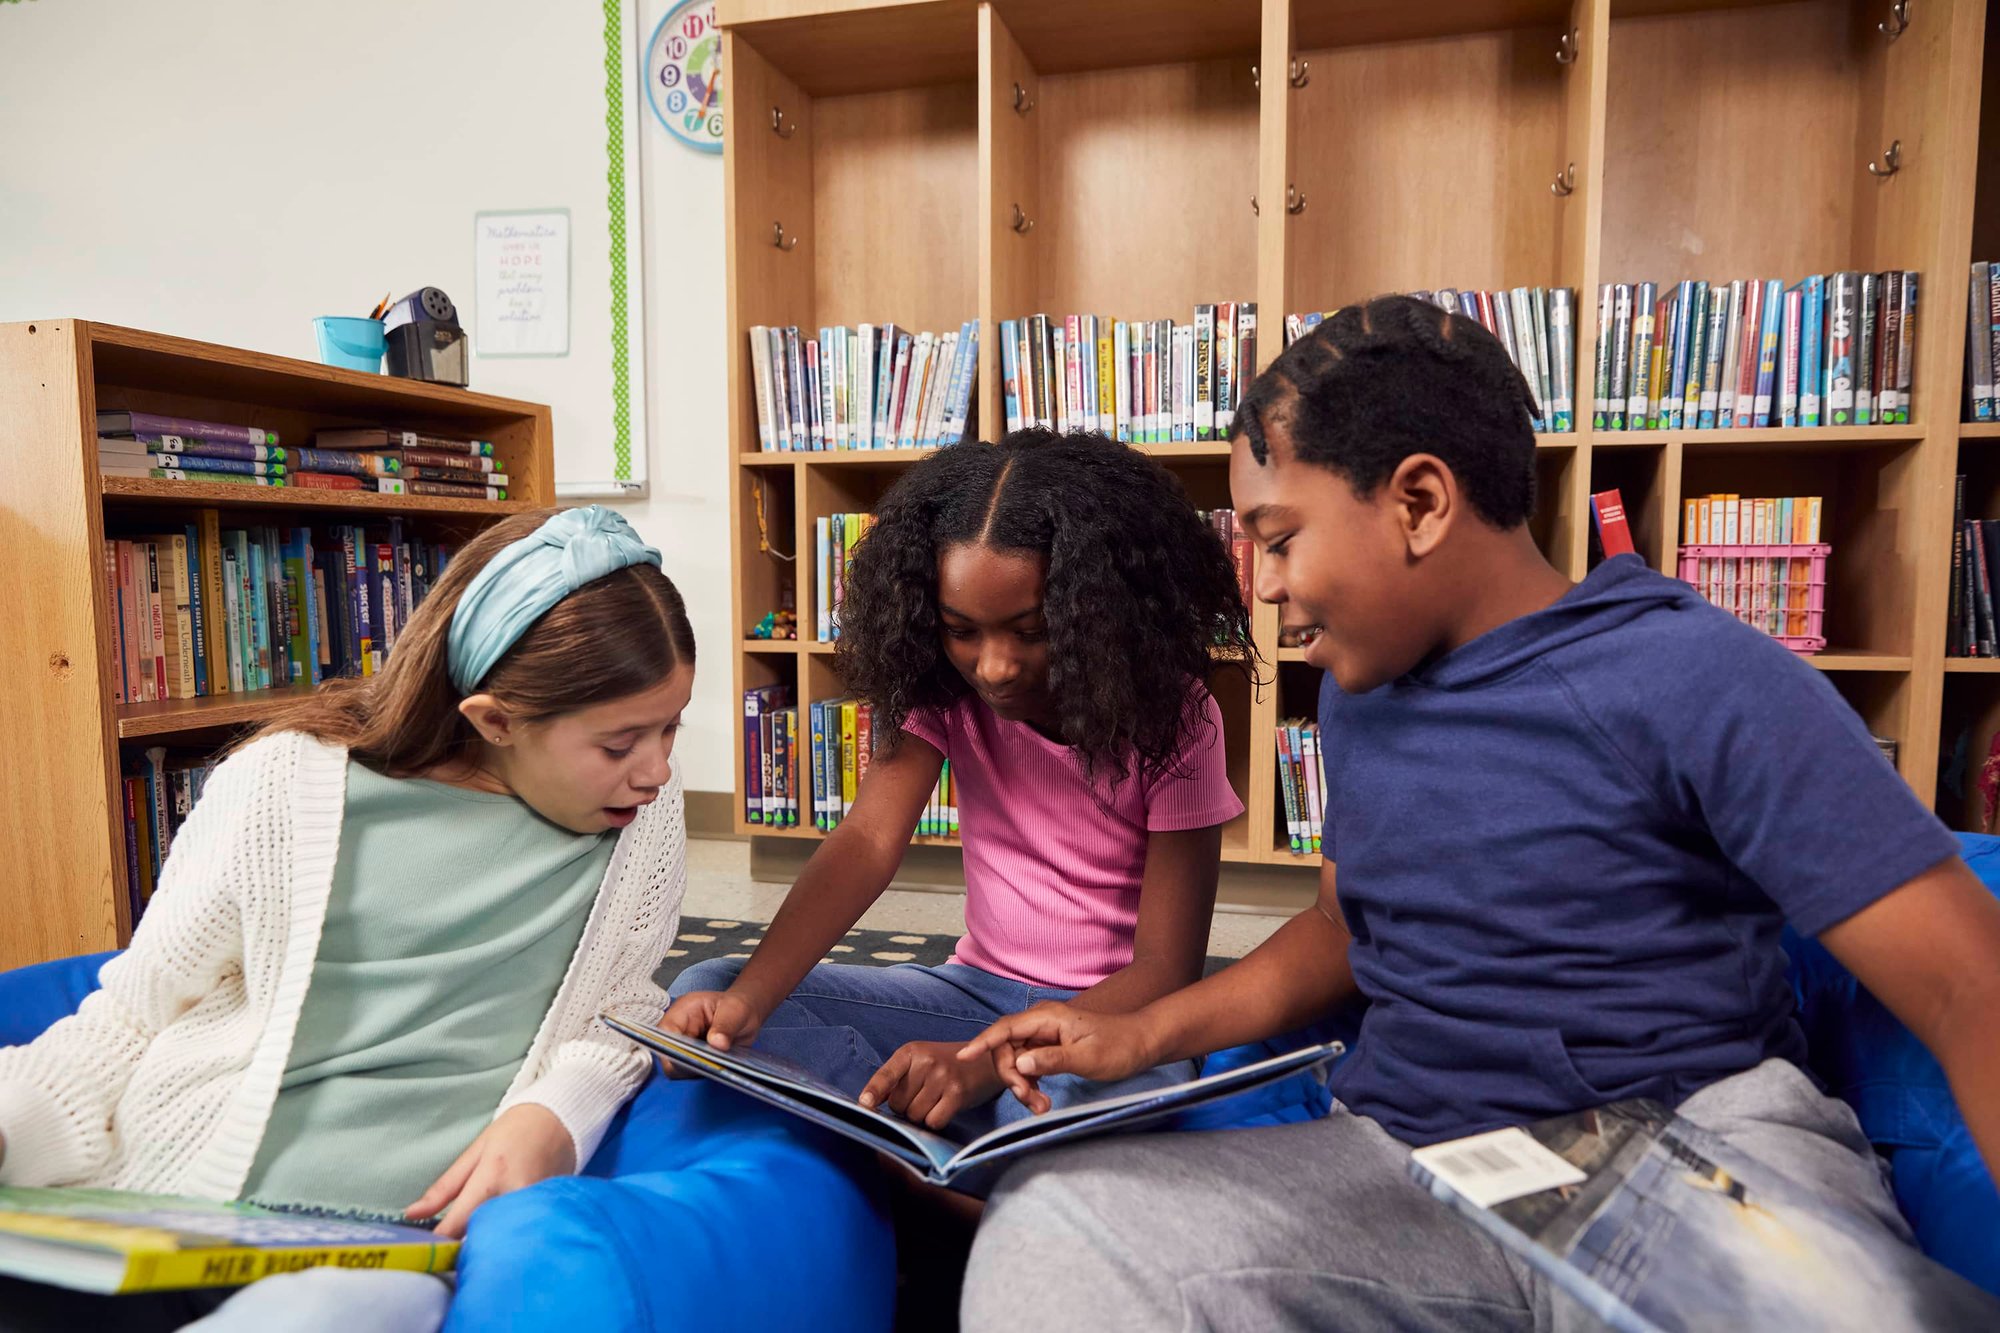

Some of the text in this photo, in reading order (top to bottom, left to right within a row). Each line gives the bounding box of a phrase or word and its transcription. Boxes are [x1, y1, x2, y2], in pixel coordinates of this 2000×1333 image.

[683, 15, 703, 38] 11
[666, 36, 687, 60] 10
[661, 64, 680, 87] 9
[667, 90, 687, 113] 8
[707, 114, 723, 137] 6
[500, 255, 542, 266] HOPE
[1197, 341, 1210, 378] STORY
[213, 555, 221, 593] CRISPIN
[192, 573, 200, 605] LINCOLN'S
[152, 604, 162, 641] UNGIFTED
[181, 632, 191, 684] Underneath
[858, 729, 869, 751] THE
[202, 1249, 388, 1285] HER RIGHT FOOT
